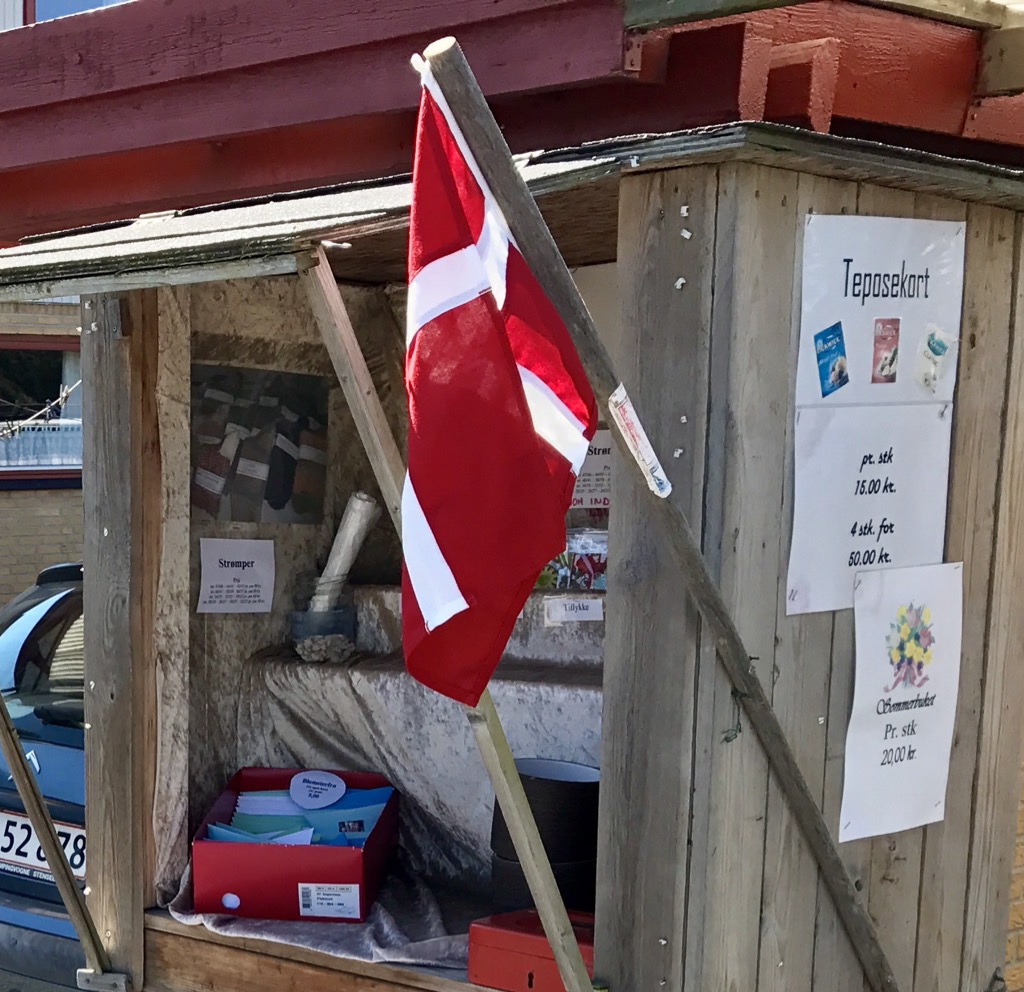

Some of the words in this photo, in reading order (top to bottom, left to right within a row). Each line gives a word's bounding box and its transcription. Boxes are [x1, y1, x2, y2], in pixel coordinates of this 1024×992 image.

[843, 258, 930, 306] Teposekort
[859, 453, 875, 473] pr.
[878, 446, 894, 464] stk
[855, 478, 881, 495] 15.00
[882, 476, 896, 494] kr.
[850, 521, 858, 537] 4
[858, 519, 875, 536] stk.
[876, 517, 895, 542] for
[848, 548, 876, 567] 50.00
[877, 547, 892, 564] kr.
[884, 723, 898, 740] Pr.
[901, 719, 918, 737] stk
[880, 745, 906, 767] 20,00
[0, 819, 33, 858] 52
